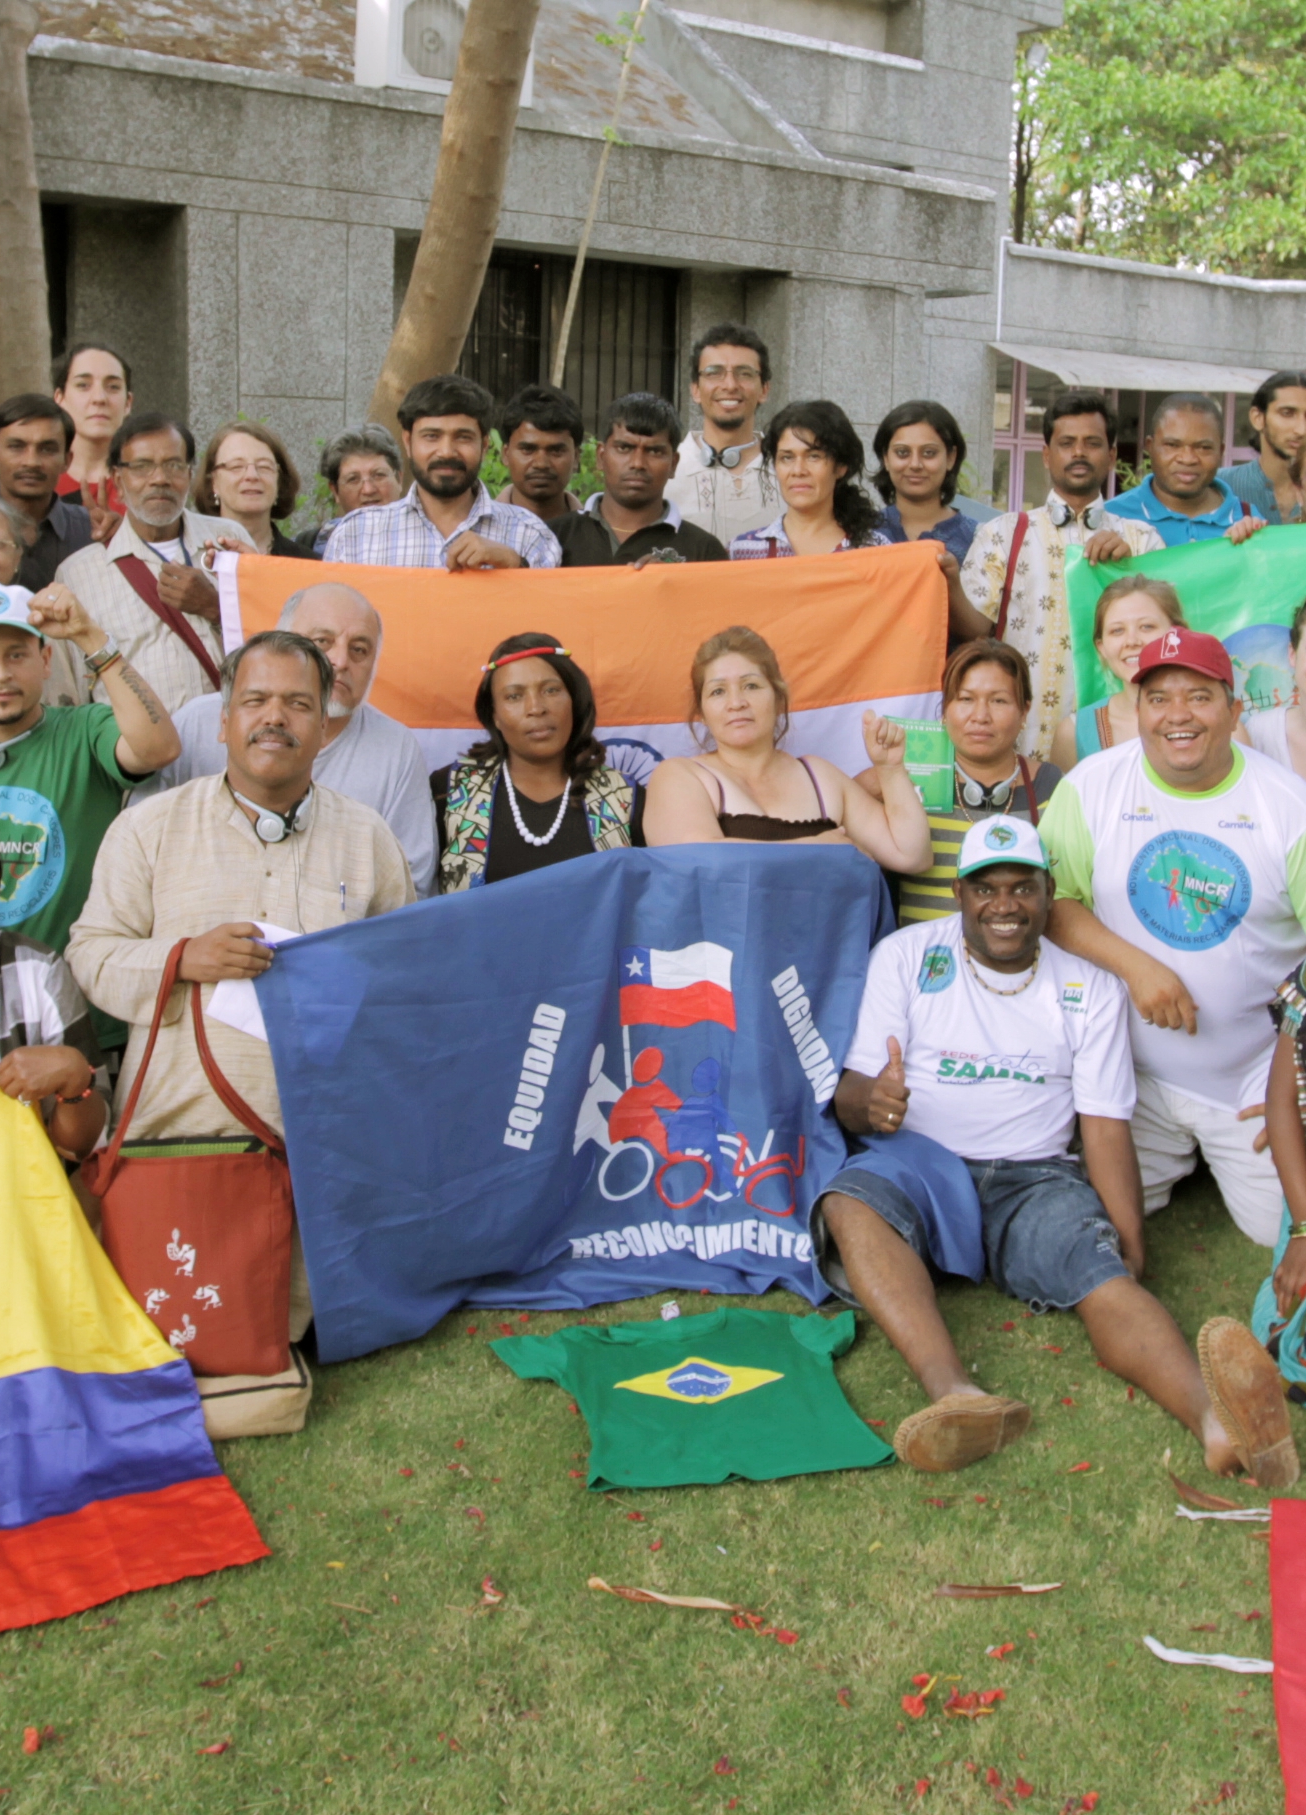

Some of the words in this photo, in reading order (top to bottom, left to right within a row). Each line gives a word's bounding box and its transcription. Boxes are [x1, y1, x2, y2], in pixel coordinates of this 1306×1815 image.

[17, 791, 38, 805] DOS
[0, 841, 41, 855] MNCR
[1129, 843, 1156, 896] MOVIMENTO
[1202, 837, 1223, 852] DOS
[1223, 847, 1250, 903] CATADORES
[1184, 876, 1230, 898] MNCR
[1139, 908, 1151, 920] DE
[1149, 918, 1192, 944] MATERIAIS
[771, 965, 839, 1104] DIGNIDAD
[503, 1003, 566, 1151] EQUIDAD
[569, 1219, 812, 1263] RECONOCIMIENTO
